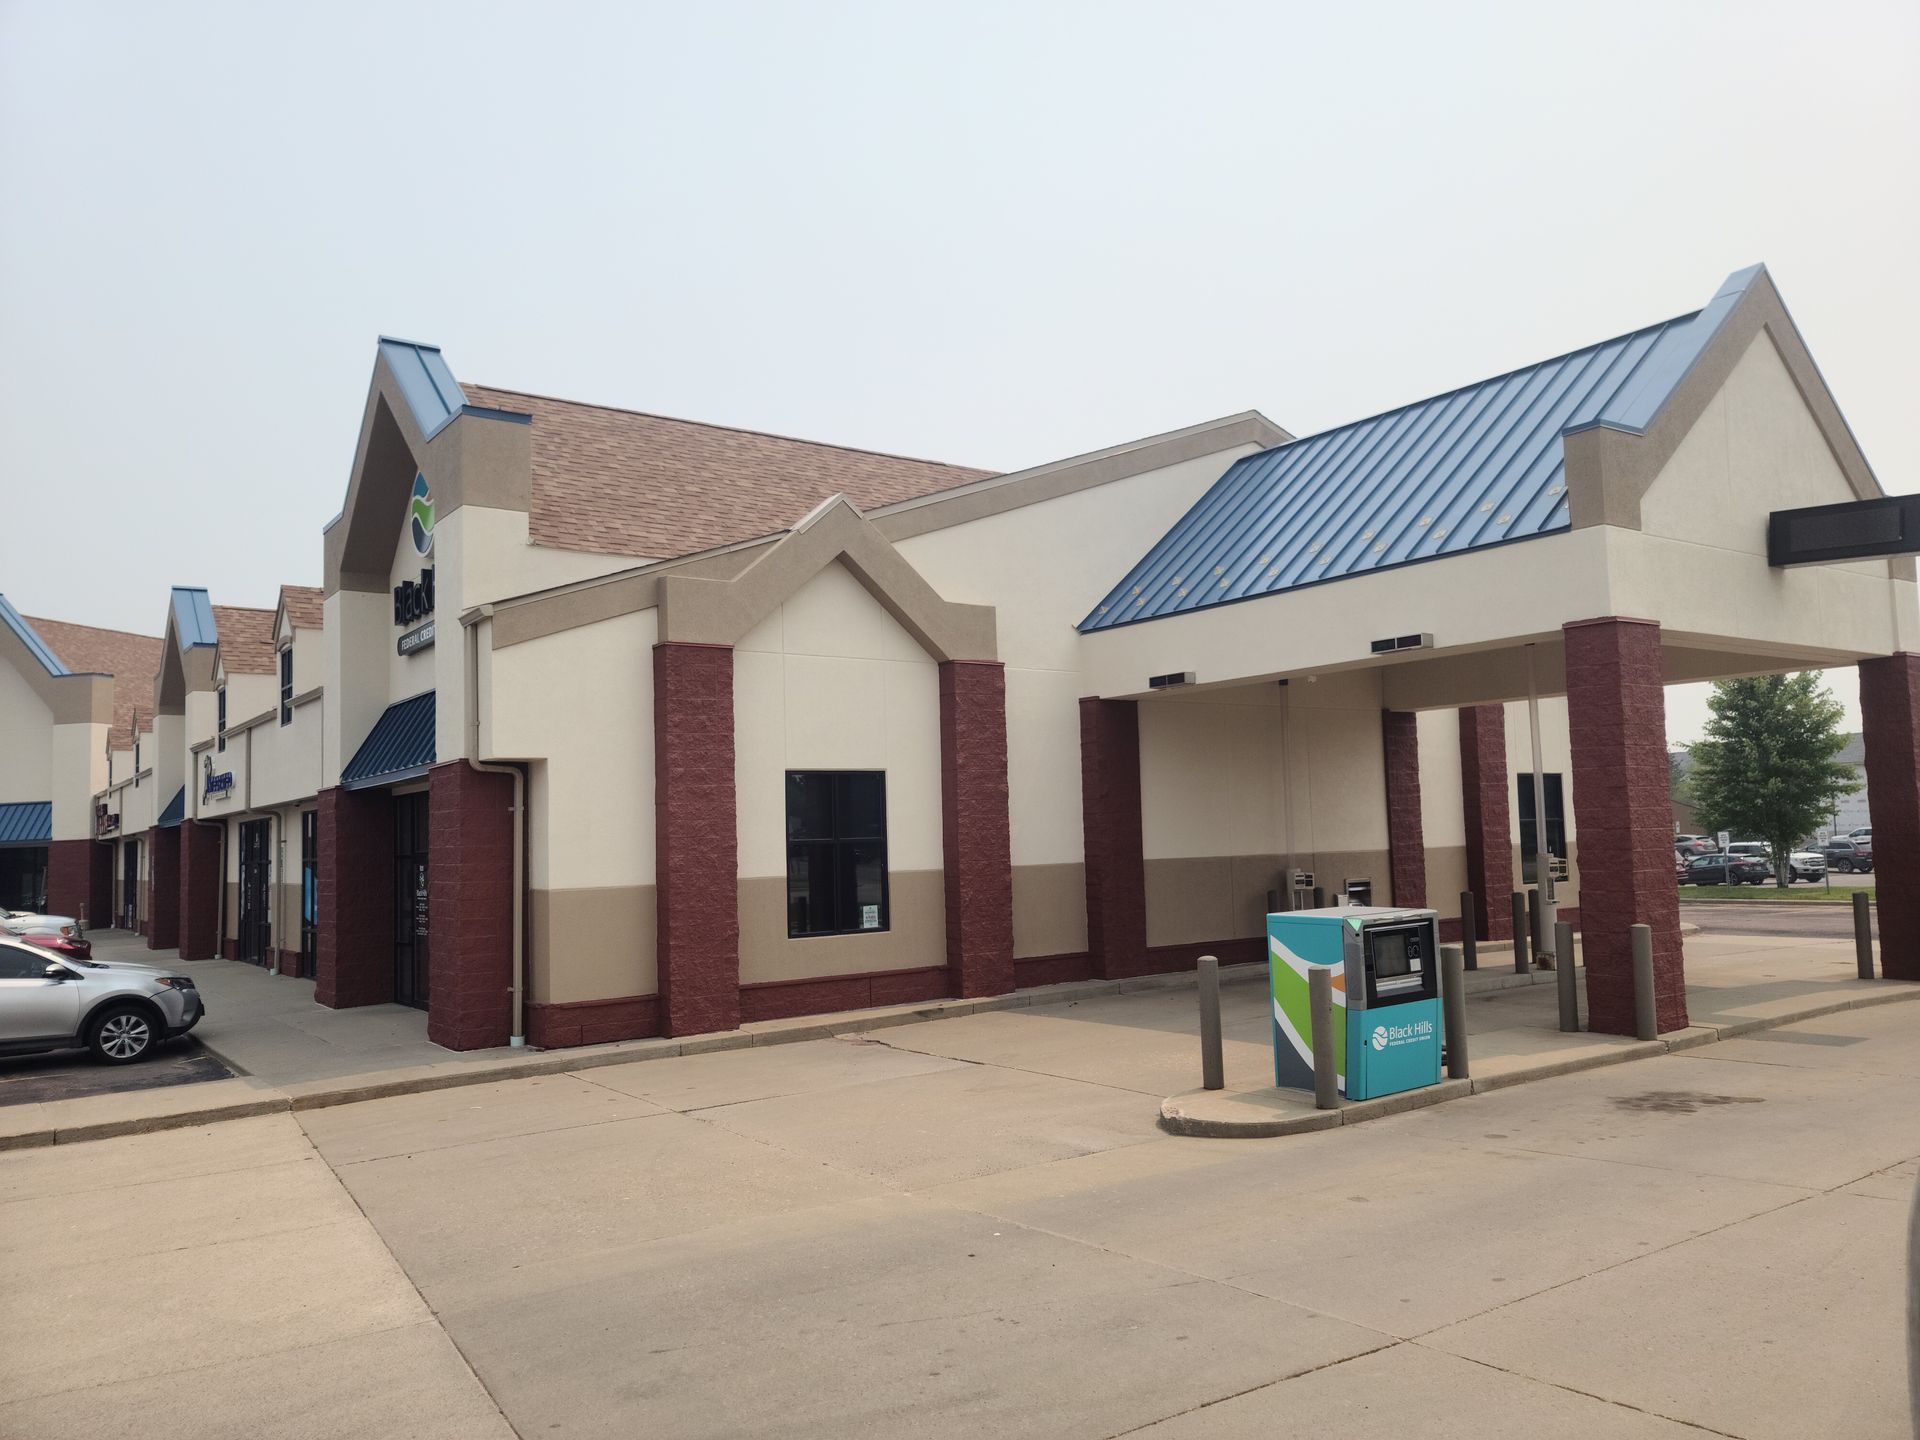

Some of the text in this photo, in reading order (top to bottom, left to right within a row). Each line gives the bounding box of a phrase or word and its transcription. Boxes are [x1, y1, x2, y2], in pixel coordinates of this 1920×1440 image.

[394, 569, 433, 625] Black
[401, 634, 420, 651] FEDERAL
[1389, 1021, 1433, 1040] Black Hills
